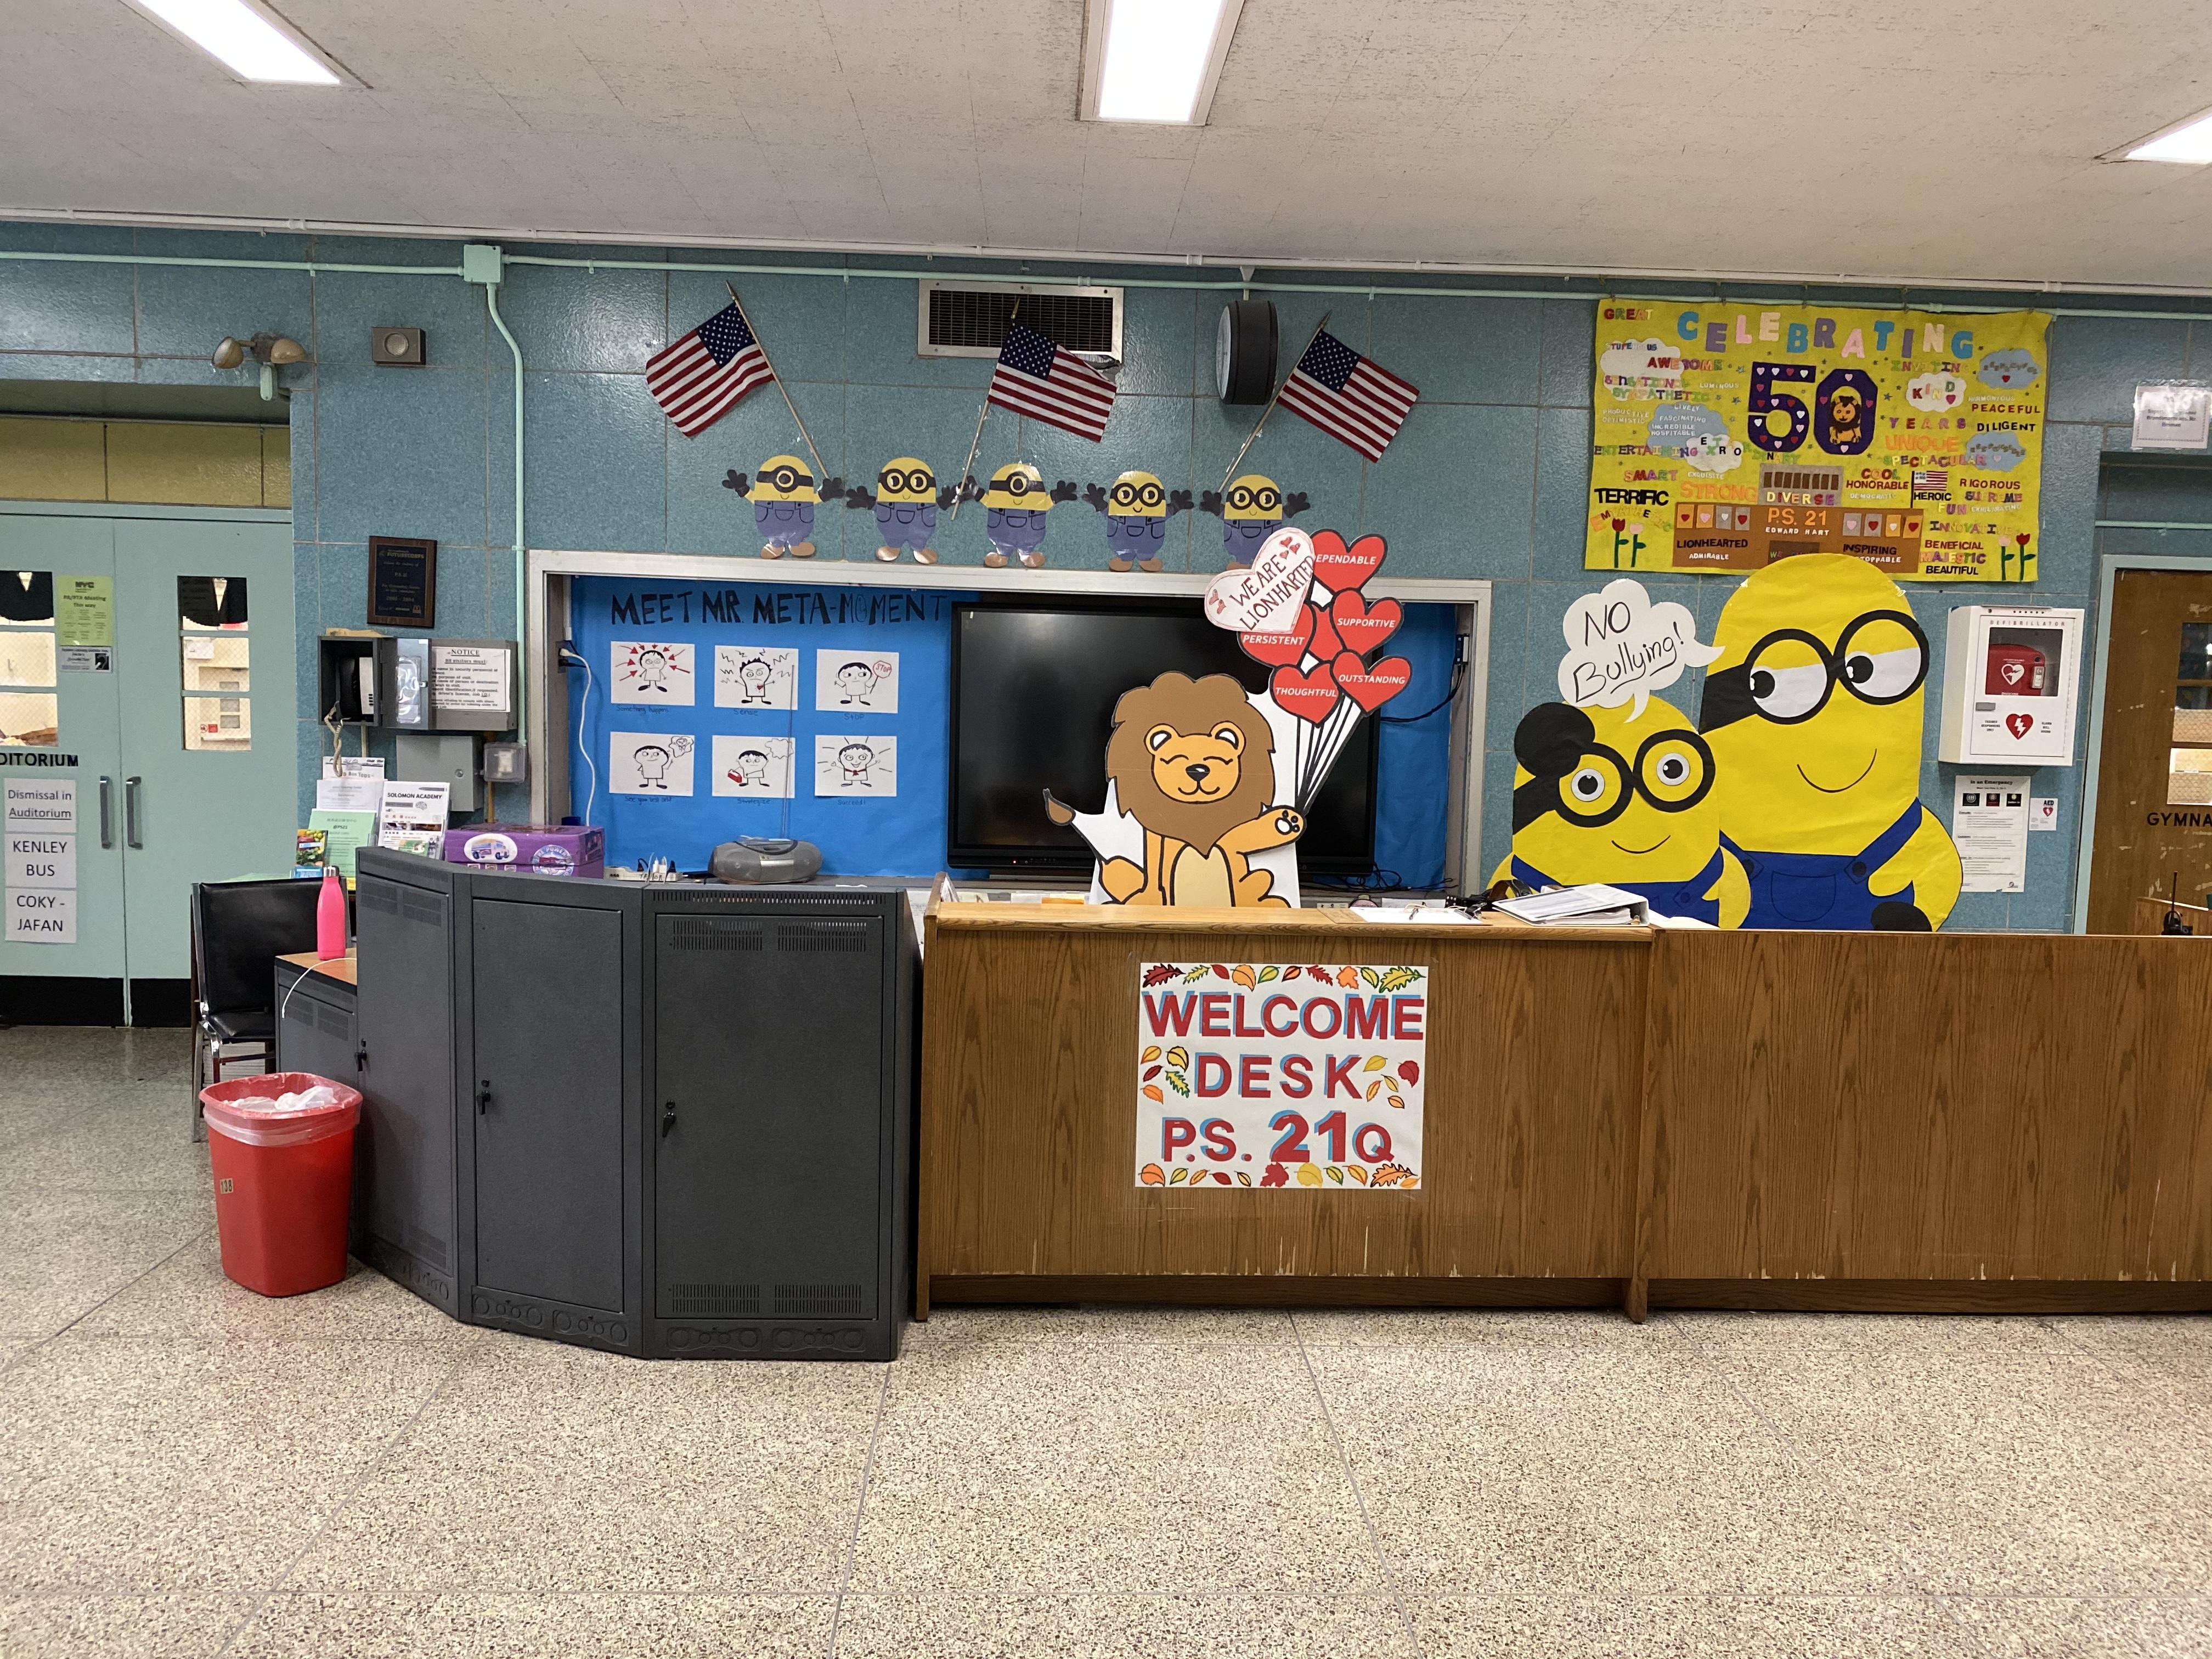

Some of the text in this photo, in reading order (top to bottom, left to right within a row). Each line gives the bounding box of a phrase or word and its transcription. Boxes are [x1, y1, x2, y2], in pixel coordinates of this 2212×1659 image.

[1604, 308, 1654, 320] GREAT
[1677, 311, 1973, 359] CELEBRATING
[1647, 357, 1723, 371] AWESOME
[1912, 381, 1955, 400] KIND
[1748, 361, 1878, 455] 50
[1972, 403, 2041, 414] PEACEFUL
[1889, 417, 1966, 429] YEARS
[1977, 421, 2036, 432] DILIGENT
[1885, 434, 1959, 453] UNIQUE
[1883, 454, 1987, 467] SPECTACULAR
[1624, 469, 1678, 482] SMART
[1860, 468, 1900, 480] COOL
[1846, 480, 1909, 490] HONORABLE
[1960, 478, 2021, 490] RIGOROUS
[1594, 488, 1669, 506] TERRIFIC
[1680, 481, 1758, 501] STRONG
[1913, 492, 1952, 501] HEROIC
[1767, 492, 1835, 506] DIVERSE
[1938, 503, 1967, 515] FUN
[1768, 507, 1827, 526] P.S. 21
[1677, 539, 1748, 549] LIONHEARTED
[1843, 544, 1897, 555] INSPIRING
[1925, 539, 1984, 550] BENEFICIAL
[1316, 554, 1376, 565] EPENDABLE
[1920, 551, 1987, 564] MAJESTIC
[1926, 566, 1979, 575] BEAUTIFUL
[1229, 555, 1286, 606] WE ARE
[612, 590, 947, 625] MEET MR. META-MOMENT
[1336, 618, 1396, 628] SUPPORTIVE
[1585, 602, 1630, 646] NO
[1243, 635, 1305, 646] PERSISTENT
[876, 663, 891, 673] STOP
[1573, 621, 1684, 703] Bullying!
[1339, 674, 1406, 685] OUTSTANDING
[1276, 687, 1338, 698] THOUGHTFUL
[8, 790, 71, 800] Dismissal in
[9, 808, 71, 818] Auditorium
[2147, 812, 2212, 827] GYMNA
[13, 840, 67, 853] KENLEY
[27, 865, 55, 876] BUS
[17, 895, 55, 908] COKY
[18, 919, 63, 932] JAFAN
[1141, 991, 1425, 1040] WELCOME
[1194, 1052, 1363, 1099] DESK
[1162, 1117, 1252, 1163] P.S.
[221, 1180, 233, 1193] 138
